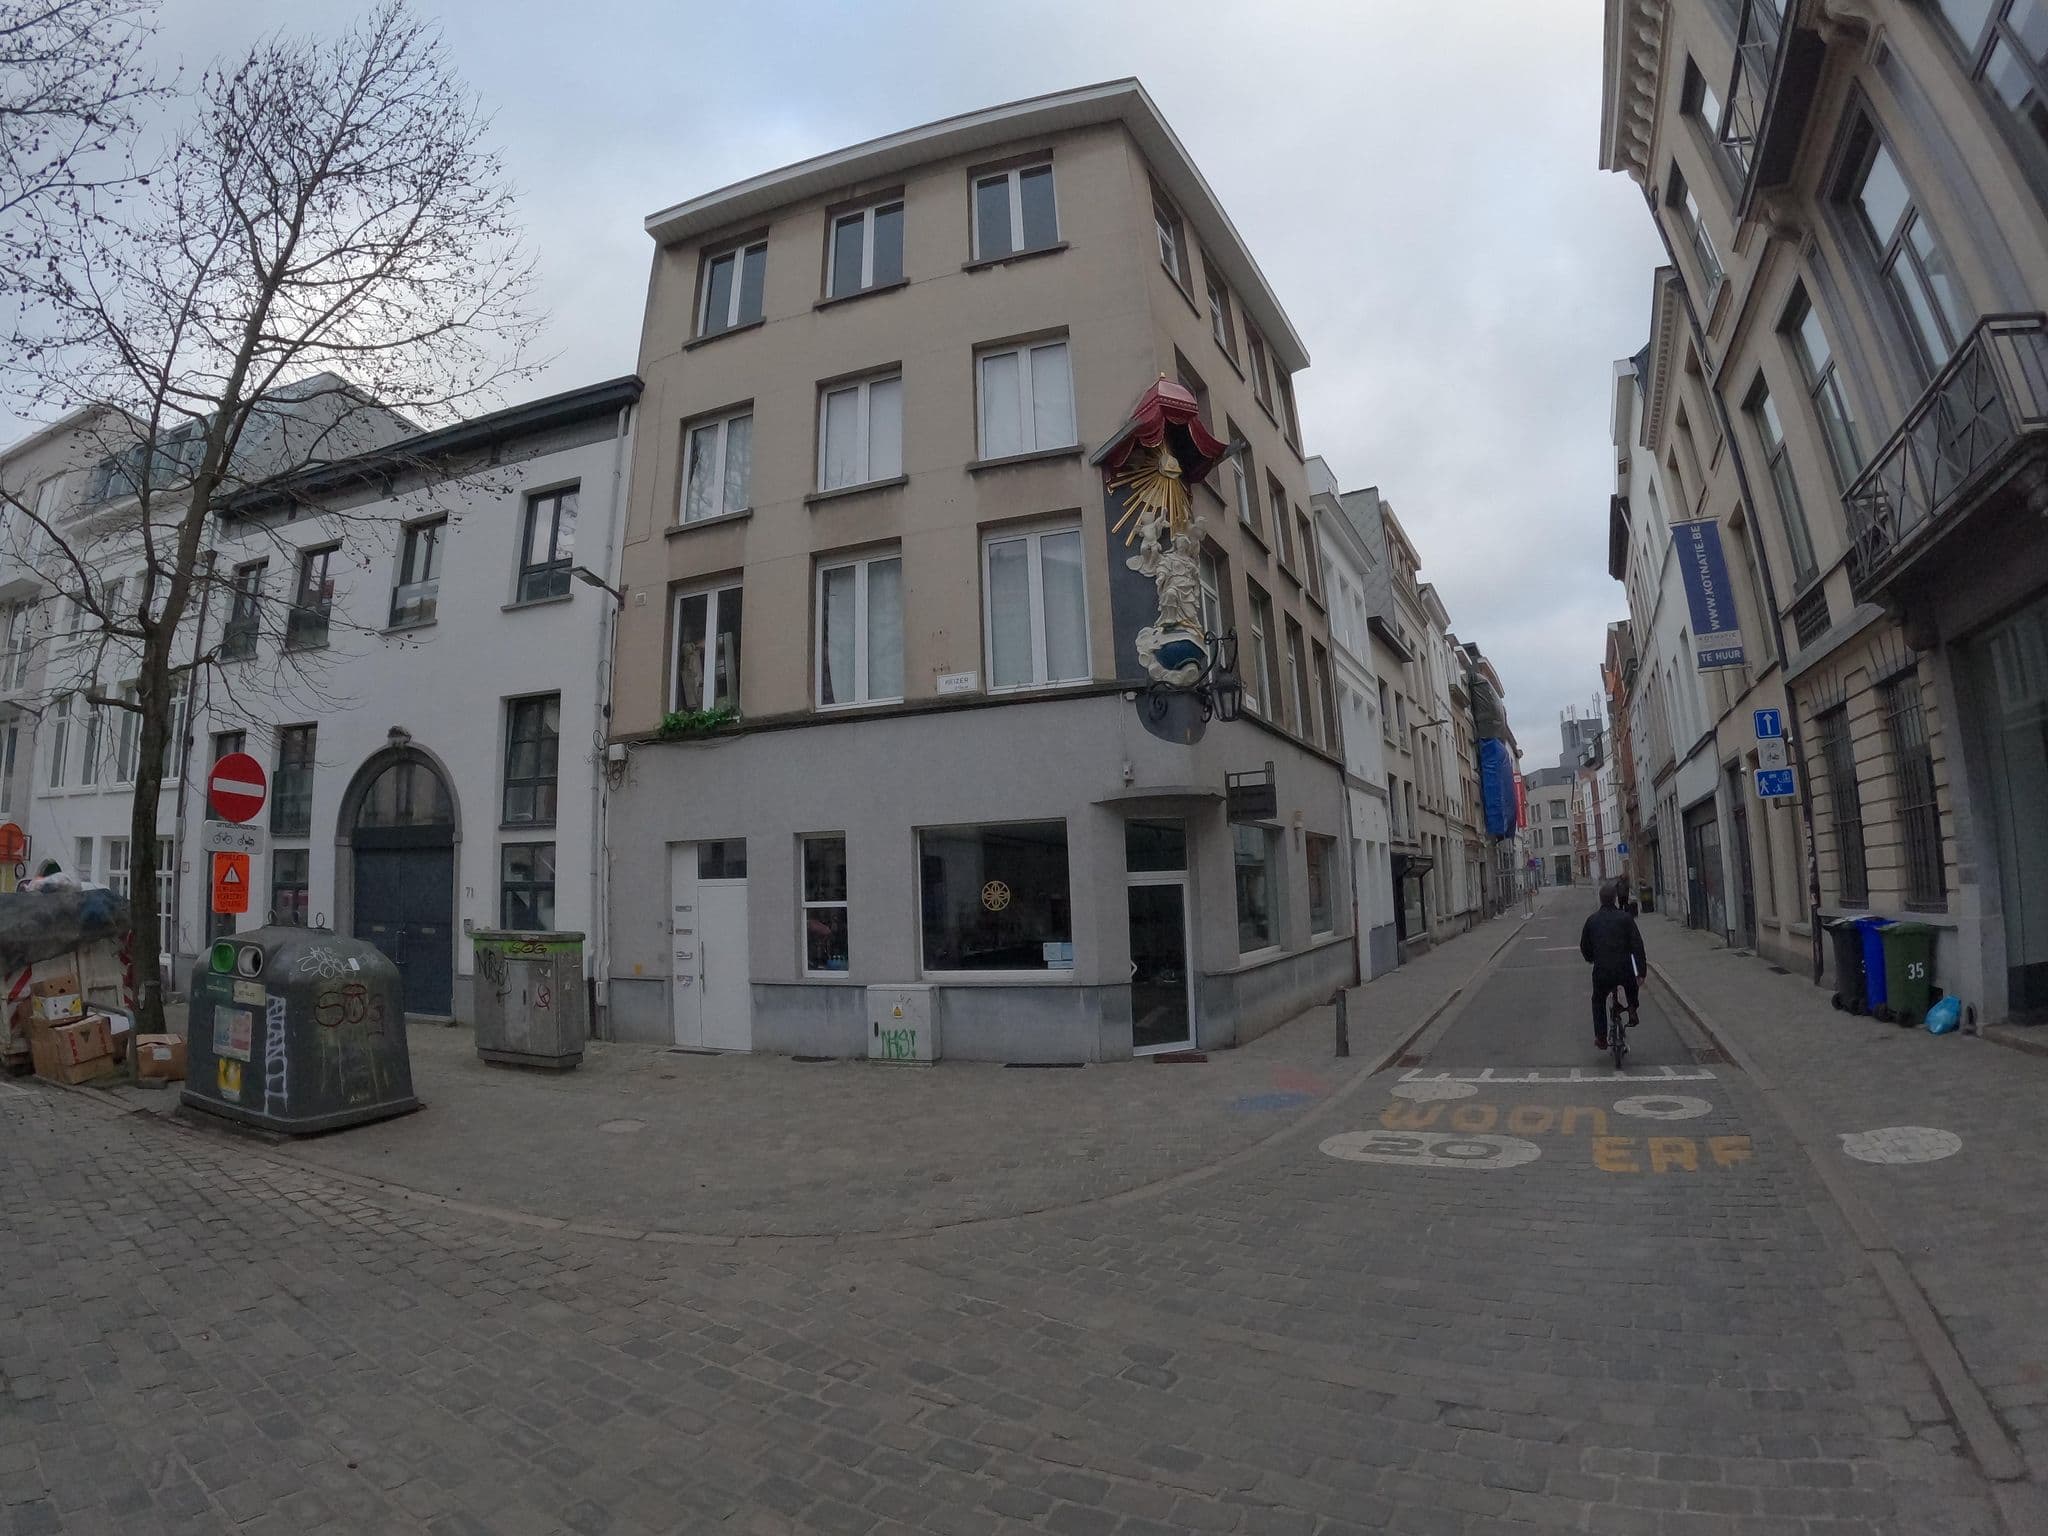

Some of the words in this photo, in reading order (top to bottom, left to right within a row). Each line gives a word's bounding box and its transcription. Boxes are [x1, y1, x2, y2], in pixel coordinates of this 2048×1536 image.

[1690, 525, 1721, 631] WWW.KOTNATIE.BE
[1701, 652, 1713, 662] TE
[1715, 650, 1741, 661] HUUR
[465, 887, 474, 898] 71
[1907, 962, 1925, 980] 35
[1359, 1136, 1503, 1160] 20
[1592, 1135, 1752, 1174] ERF
